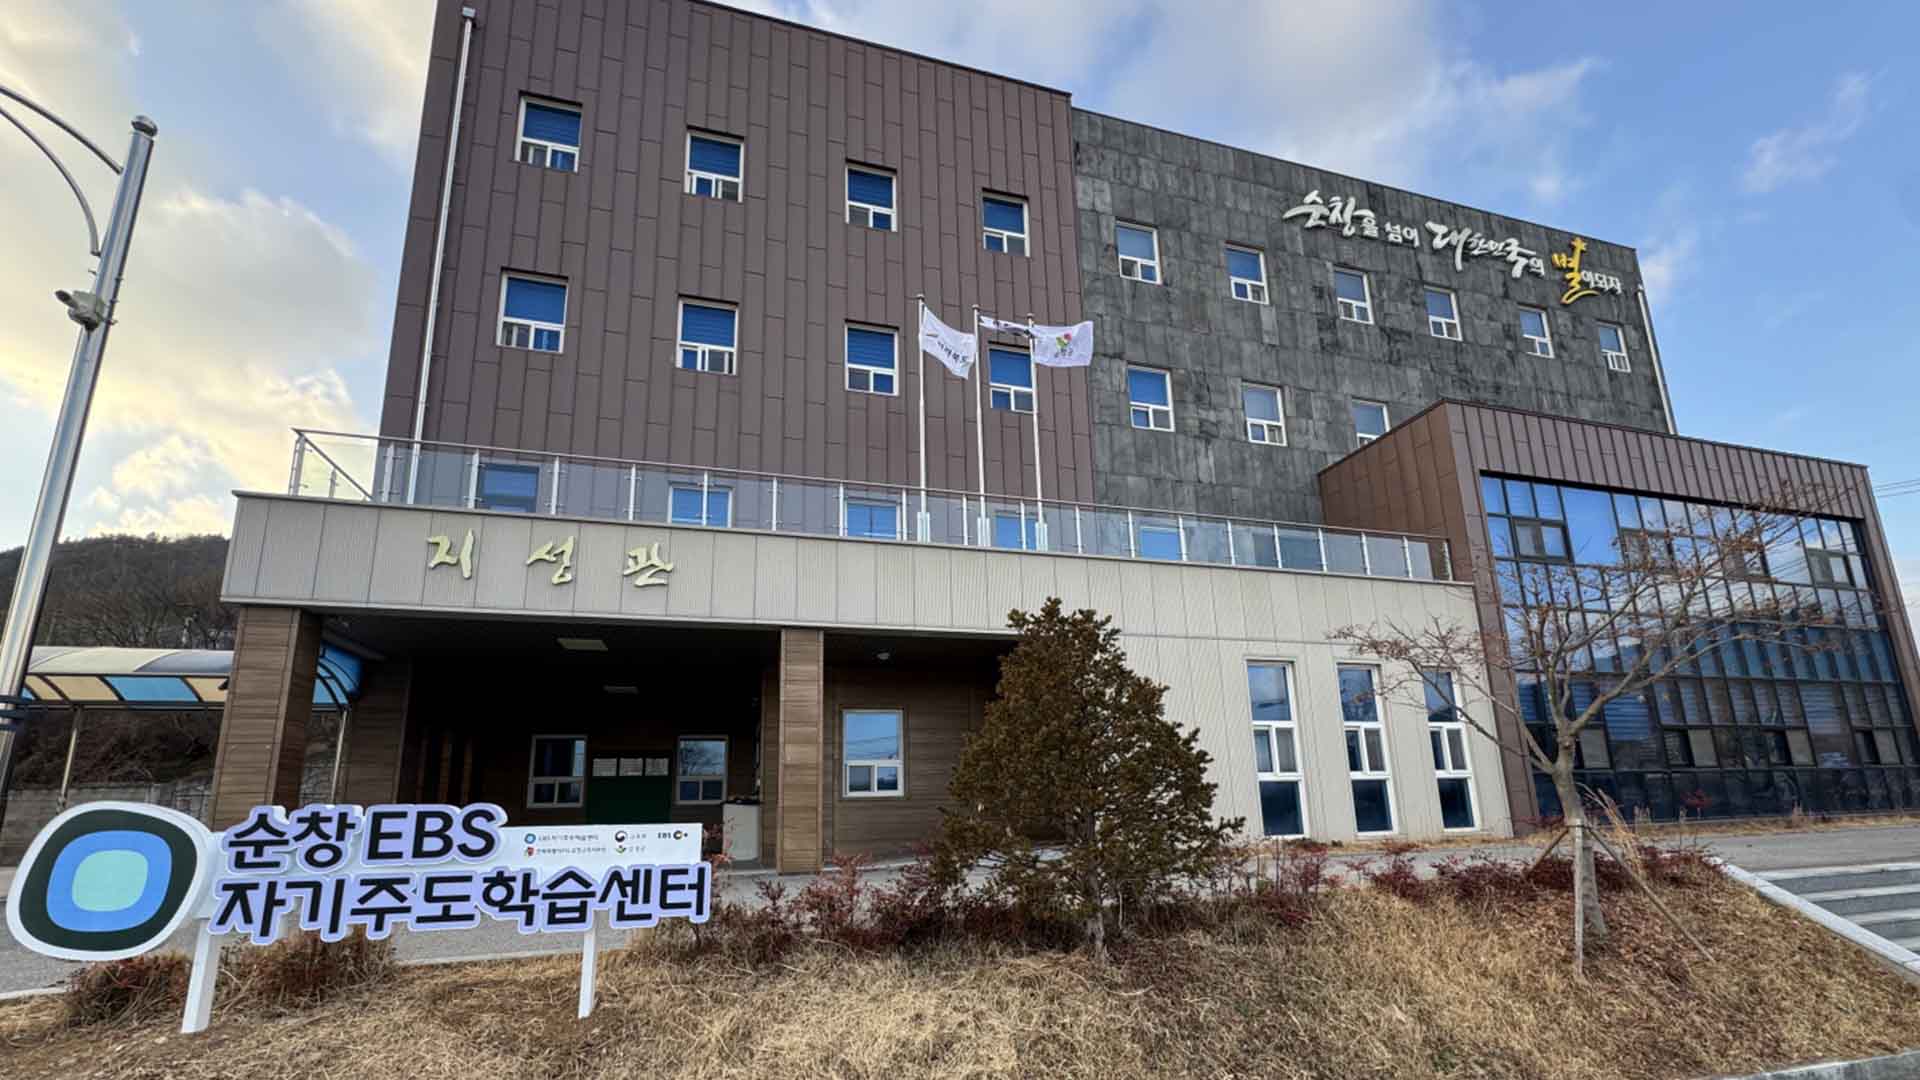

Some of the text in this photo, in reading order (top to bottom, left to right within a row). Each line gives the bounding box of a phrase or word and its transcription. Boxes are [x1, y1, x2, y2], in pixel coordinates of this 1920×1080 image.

[1282, 189, 1380, 238] 순창을
[1384, 220, 1420, 248] 넘어
[1425, 220, 1545, 279] 대한민국의
[228, 808, 497, 870] 순창 EBS
[215, 864, 709, 939] 자기주도학습센터
